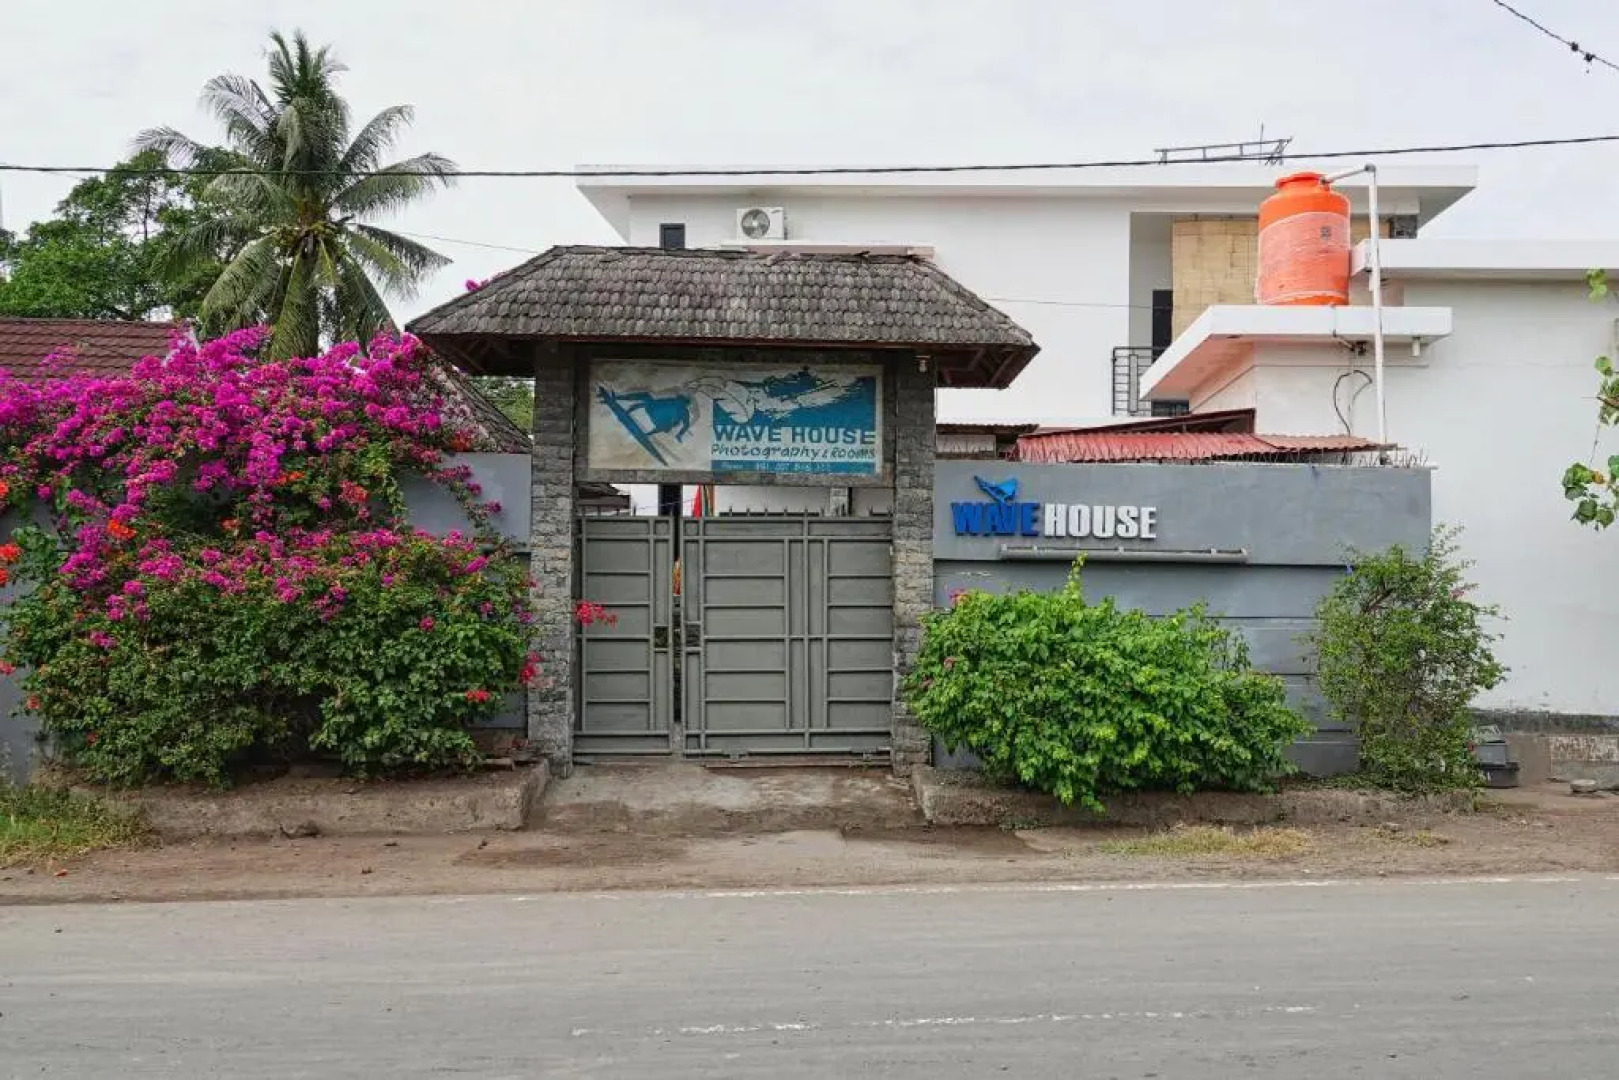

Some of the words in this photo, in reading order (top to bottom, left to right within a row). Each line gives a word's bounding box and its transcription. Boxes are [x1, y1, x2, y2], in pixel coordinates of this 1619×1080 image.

[713, 425, 781, 442] WAVE
[792, 427, 875, 445] HOUSE
[711, 443, 820, 460] Photography
[951, 503, 1040, 536] WAVE
[1044, 502, 1157, 539] HOUSE
